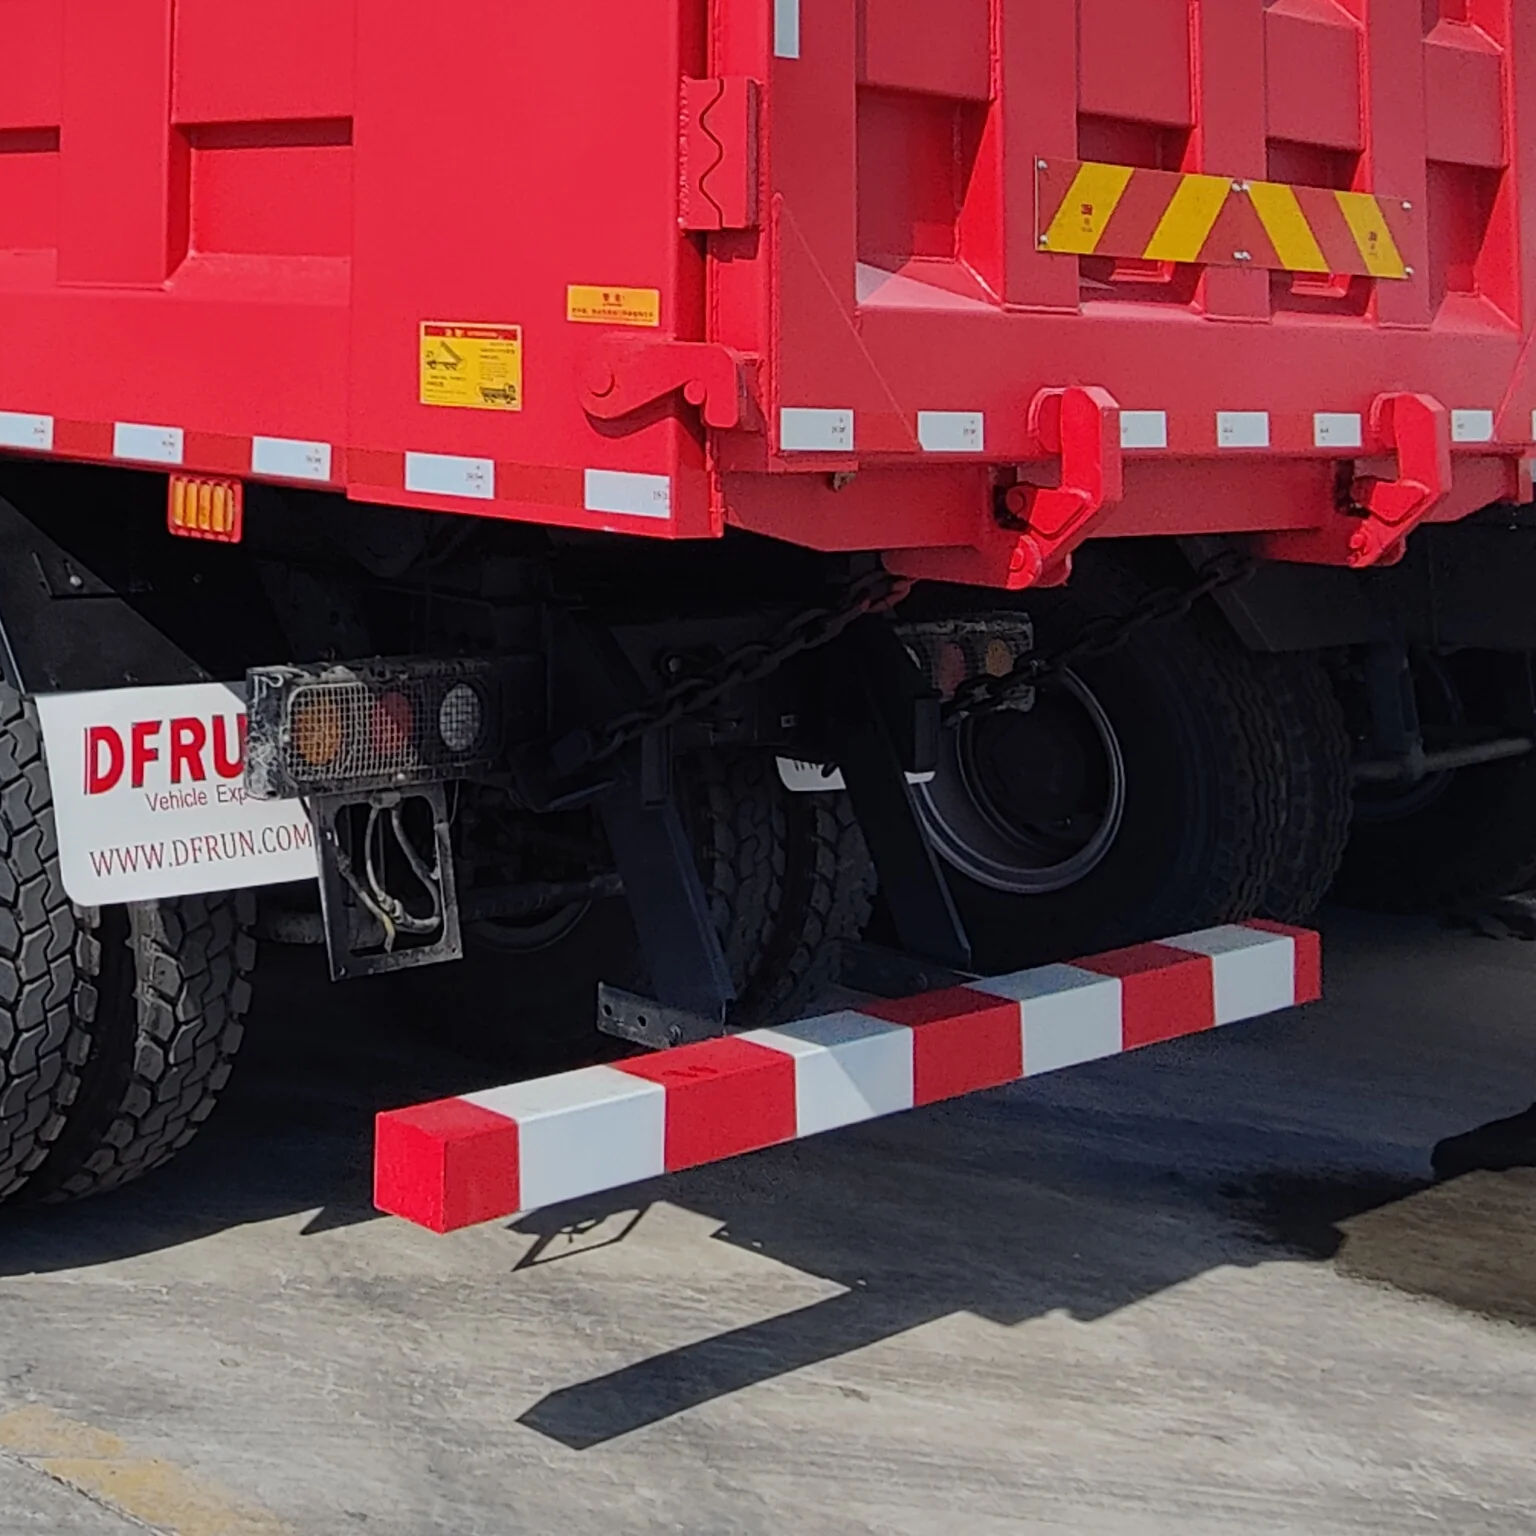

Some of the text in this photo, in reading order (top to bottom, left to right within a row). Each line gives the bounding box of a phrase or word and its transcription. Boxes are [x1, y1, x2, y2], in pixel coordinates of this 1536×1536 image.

[84, 713, 248, 795] DFRU
[145, 784, 248, 812] Vehicle Exp
[89, 823, 313, 878] WWW.DFRUN.COM
